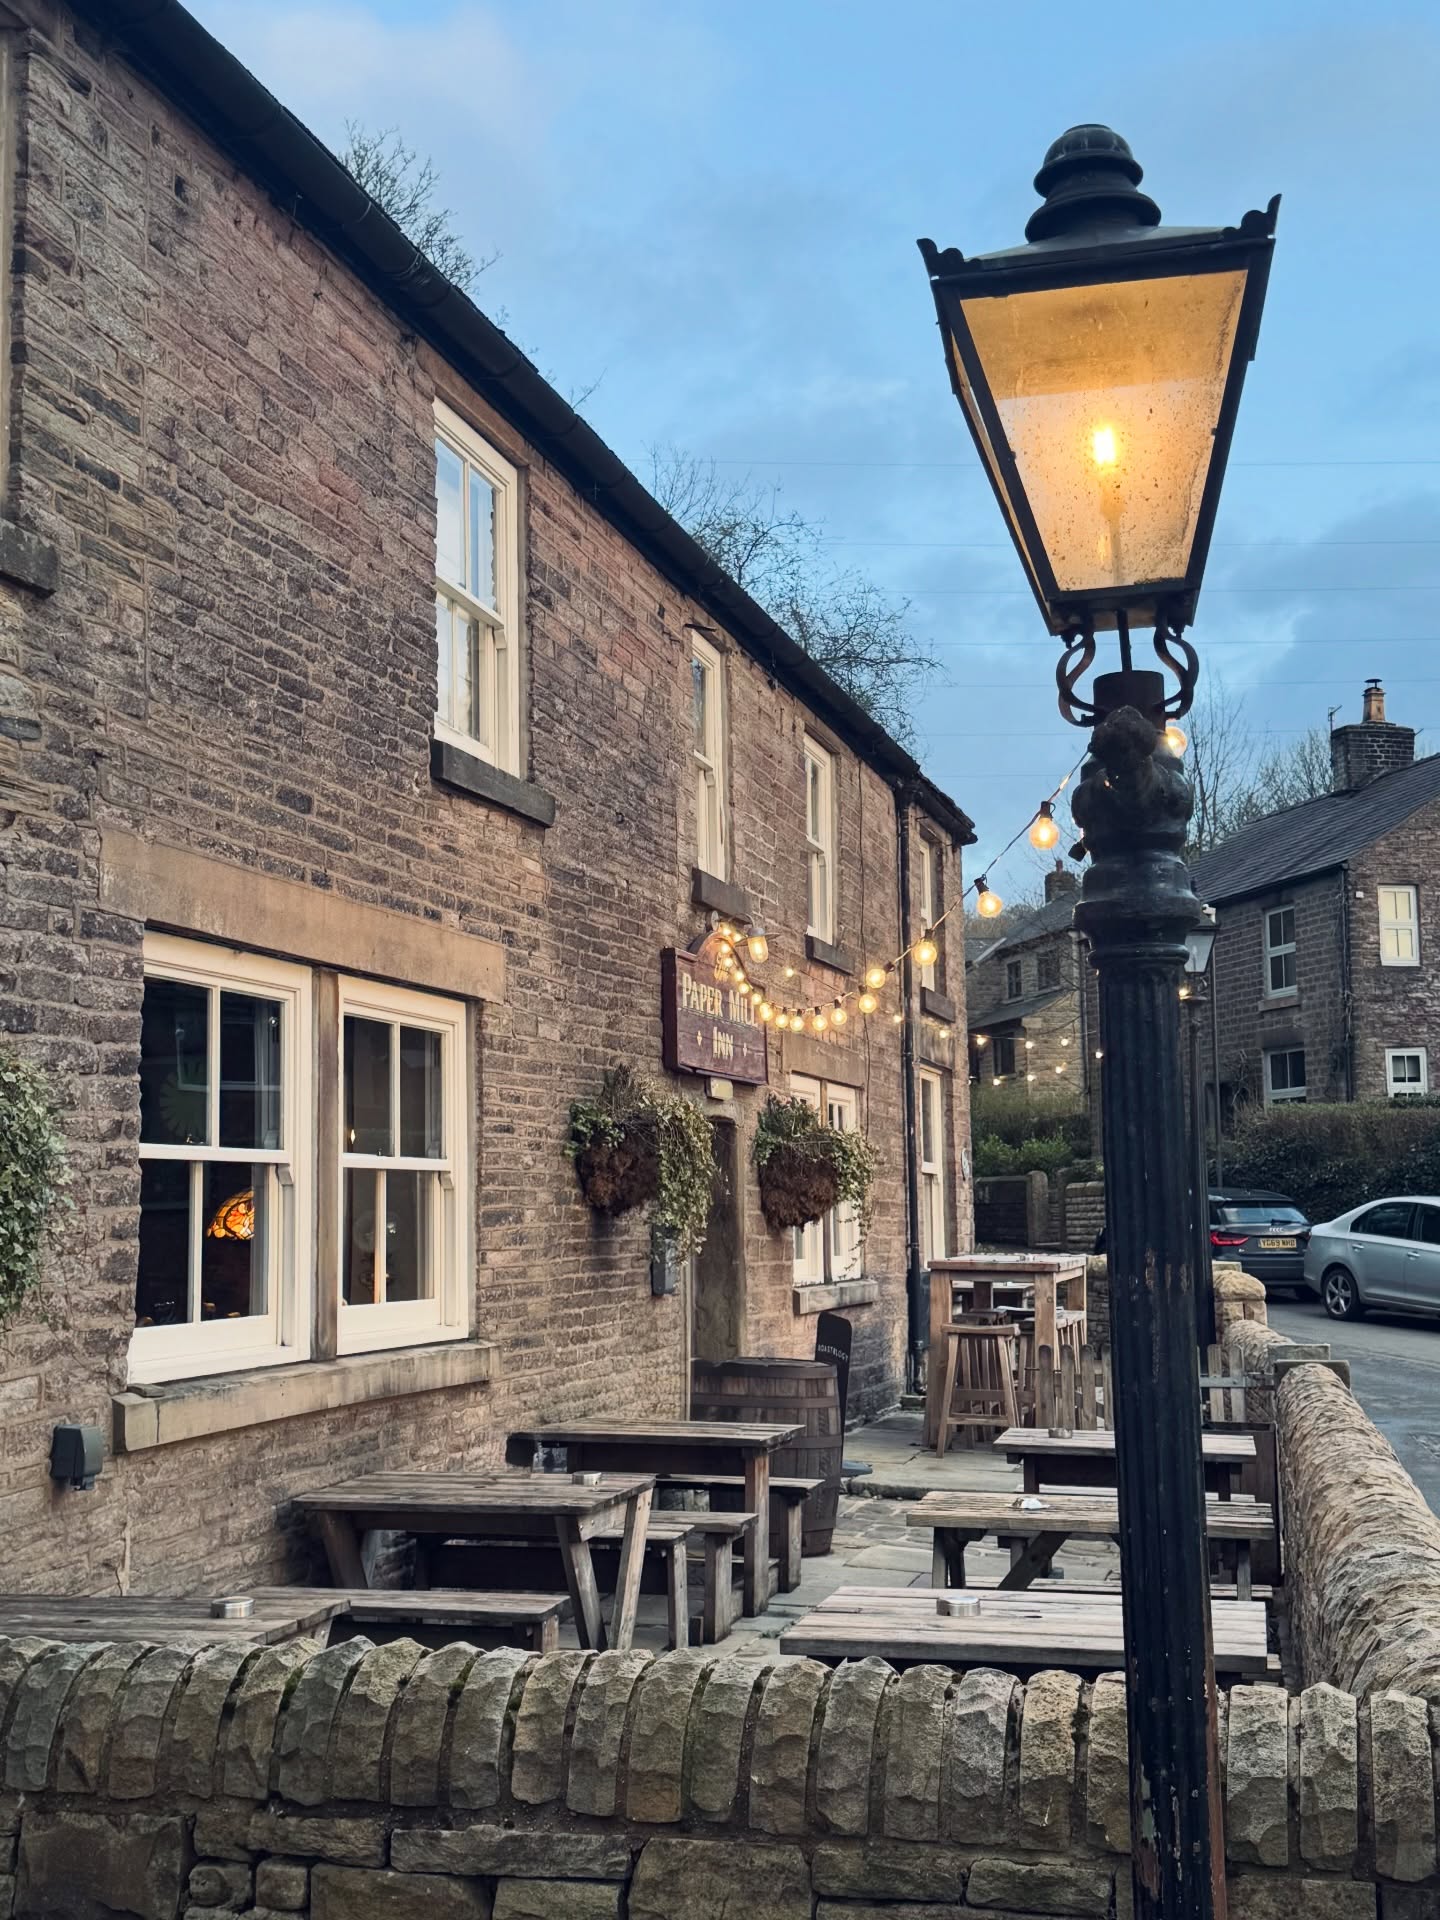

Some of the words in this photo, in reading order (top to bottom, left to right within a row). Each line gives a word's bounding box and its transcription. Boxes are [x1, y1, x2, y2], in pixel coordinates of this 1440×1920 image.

[682, 973, 723, 1017] PAPER
[729, 990, 758, 1027] MILL
[713, 1026, 733, 1059] INN
